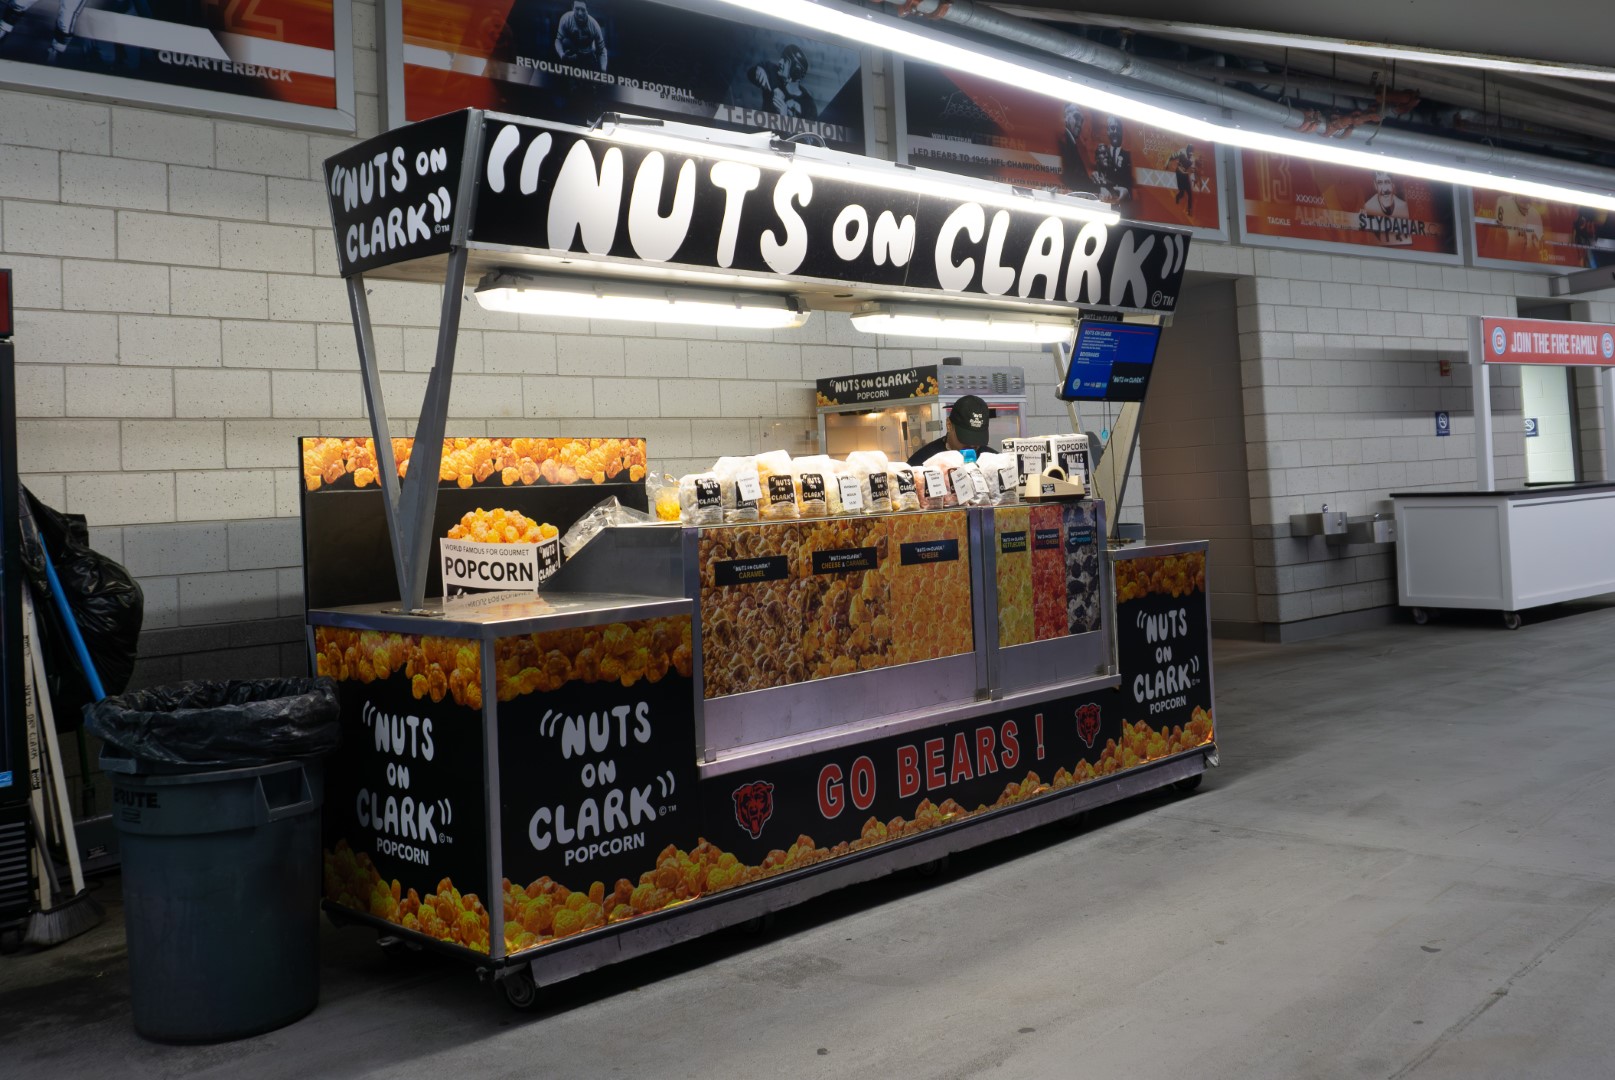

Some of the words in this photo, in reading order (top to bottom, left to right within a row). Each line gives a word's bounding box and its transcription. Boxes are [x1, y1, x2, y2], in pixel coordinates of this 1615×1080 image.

[158, 49, 293, 83] QUARTERBACK
[515, 56, 615, 85] REVOLUTIONIZED
[618, 76, 640, 90] PRO
[642, 80, 695, 100] FOOTBALL
[672, 94, 702, 106] RUNNING
[724, 105, 847, 142] T-FORMATION
[912, 147, 928, 158] LED
[930, 149, 957, 161] BEARS
[959, 154, 970, 162] TO
[990, 158, 1006, 168] NFL
[1007, 160, 1063, 174] CHAMPIONSHIP
[331, 146, 408, 213] "NUTS
[416, 146, 446, 176] ON
[346, 186, 452, 263] CLARK"
[487, 124, 813, 275] "NUTS
[832, 204, 916, 268] ON
[935, 202, 1184, 308] CLARK"
[1267, 216, 1292, 226] TACKLE
[1358, 213, 1426, 236] STYDAHAR
[1511, 332, 1532, 353] JOIN
[1532, 333, 1550, 354] THE
[1552, 334, 1570, 354] FIRE
[1570, 334, 1598, 356] FAMILY
[830, 379, 859, 393] "NUTS
[861, 379, 874, 388] ON
[875, 370, 918, 388] CLARK"
[856, 390, 889, 400] POPCORN
[1056, 442, 1088, 452] POPCORN
[771, 477, 791, 486] "NUTS
[772, 492, 794, 501] CLARK"
[445, 544, 462, 552] WORLD
[463, 545, 485, 555] FAMOUS
[445, 556, 534, 582] POPCORN
[738, 570, 766, 579] CARAMEL
[821, 561, 841, 569] CHEESE
[1136, 608, 1188, 644] "NUTS
[1156, 646, 1172, 664] ON
[1134, 656, 1200, 703] CLARK"
[1150, 695, 1186, 715] POPCORN
[362, 700, 434, 762] "NUTS
[540, 701, 652, 760] "NUTS
[386, 762, 410, 790] ON
[581, 760, 616, 788] ON
[817, 755, 877, 820] GO
[897, 720, 1020, 798] BEARS
[356, 788, 452, 844] CLARK"
[528, 770, 676, 850] CLARK"
[376, 837, 430, 866] POPCORN
[564, 832, 645, 866] POPCORN
